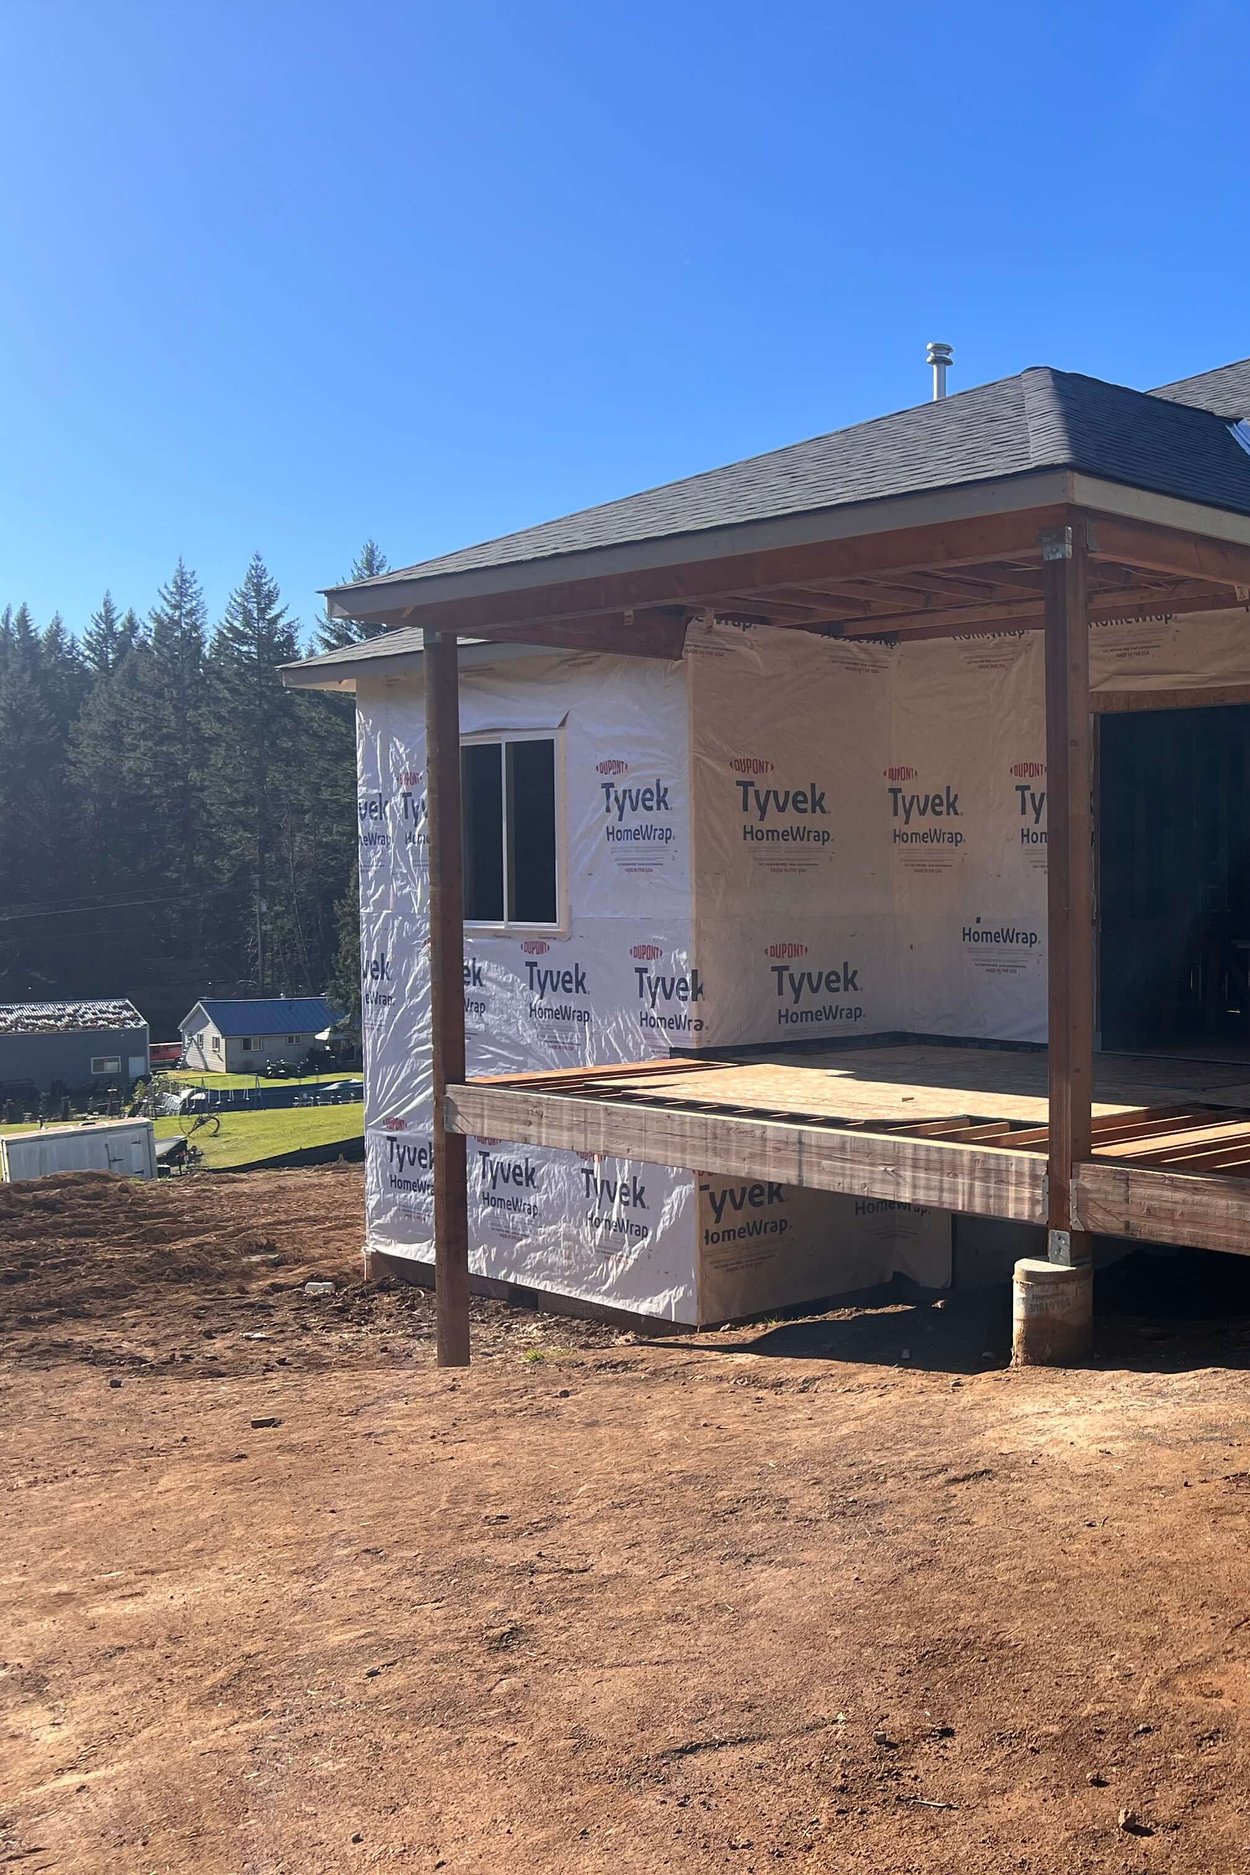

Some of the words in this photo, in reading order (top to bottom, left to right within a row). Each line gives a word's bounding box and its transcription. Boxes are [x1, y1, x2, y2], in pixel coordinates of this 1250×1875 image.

[599, 760, 625, 775] DUPONT
[734, 758, 770, 774] DUPONT
[888, 766, 914, 781] DUPONT
[1014, 762, 1044, 778] DUPONT
[601, 778, 670, 822] Tyvek
[736, 780, 827, 821] Tyvek
[888, 785, 960, 825] Tyvek
[1015, 784, 1047, 824] Ty
[606, 824, 672, 844] HomeWrap
[743, 825, 830, 846] HomeWrap
[893, 828, 963, 847] HomeWrap
[962, 926, 1038, 948] HomeWrap
[633, 944, 660, 960] DUPONT
[769, 943, 804, 959] DUPONT
[525, 961, 587, 1000] Tyvek
[634, 967, 704, 1009] Tyvek
[771, 961, 859, 1004] Tyvek
[529, 1003, 590, 1026] HomeWrap
[778, 1004, 863, 1025] HomeWrap
[478, 1150, 536, 1190] Tyvek
[581, 1168, 646, 1209] Tyvek
[482, 1191, 539, 1218] HomeWrap
[699, 1181, 785, 1224] yvek
